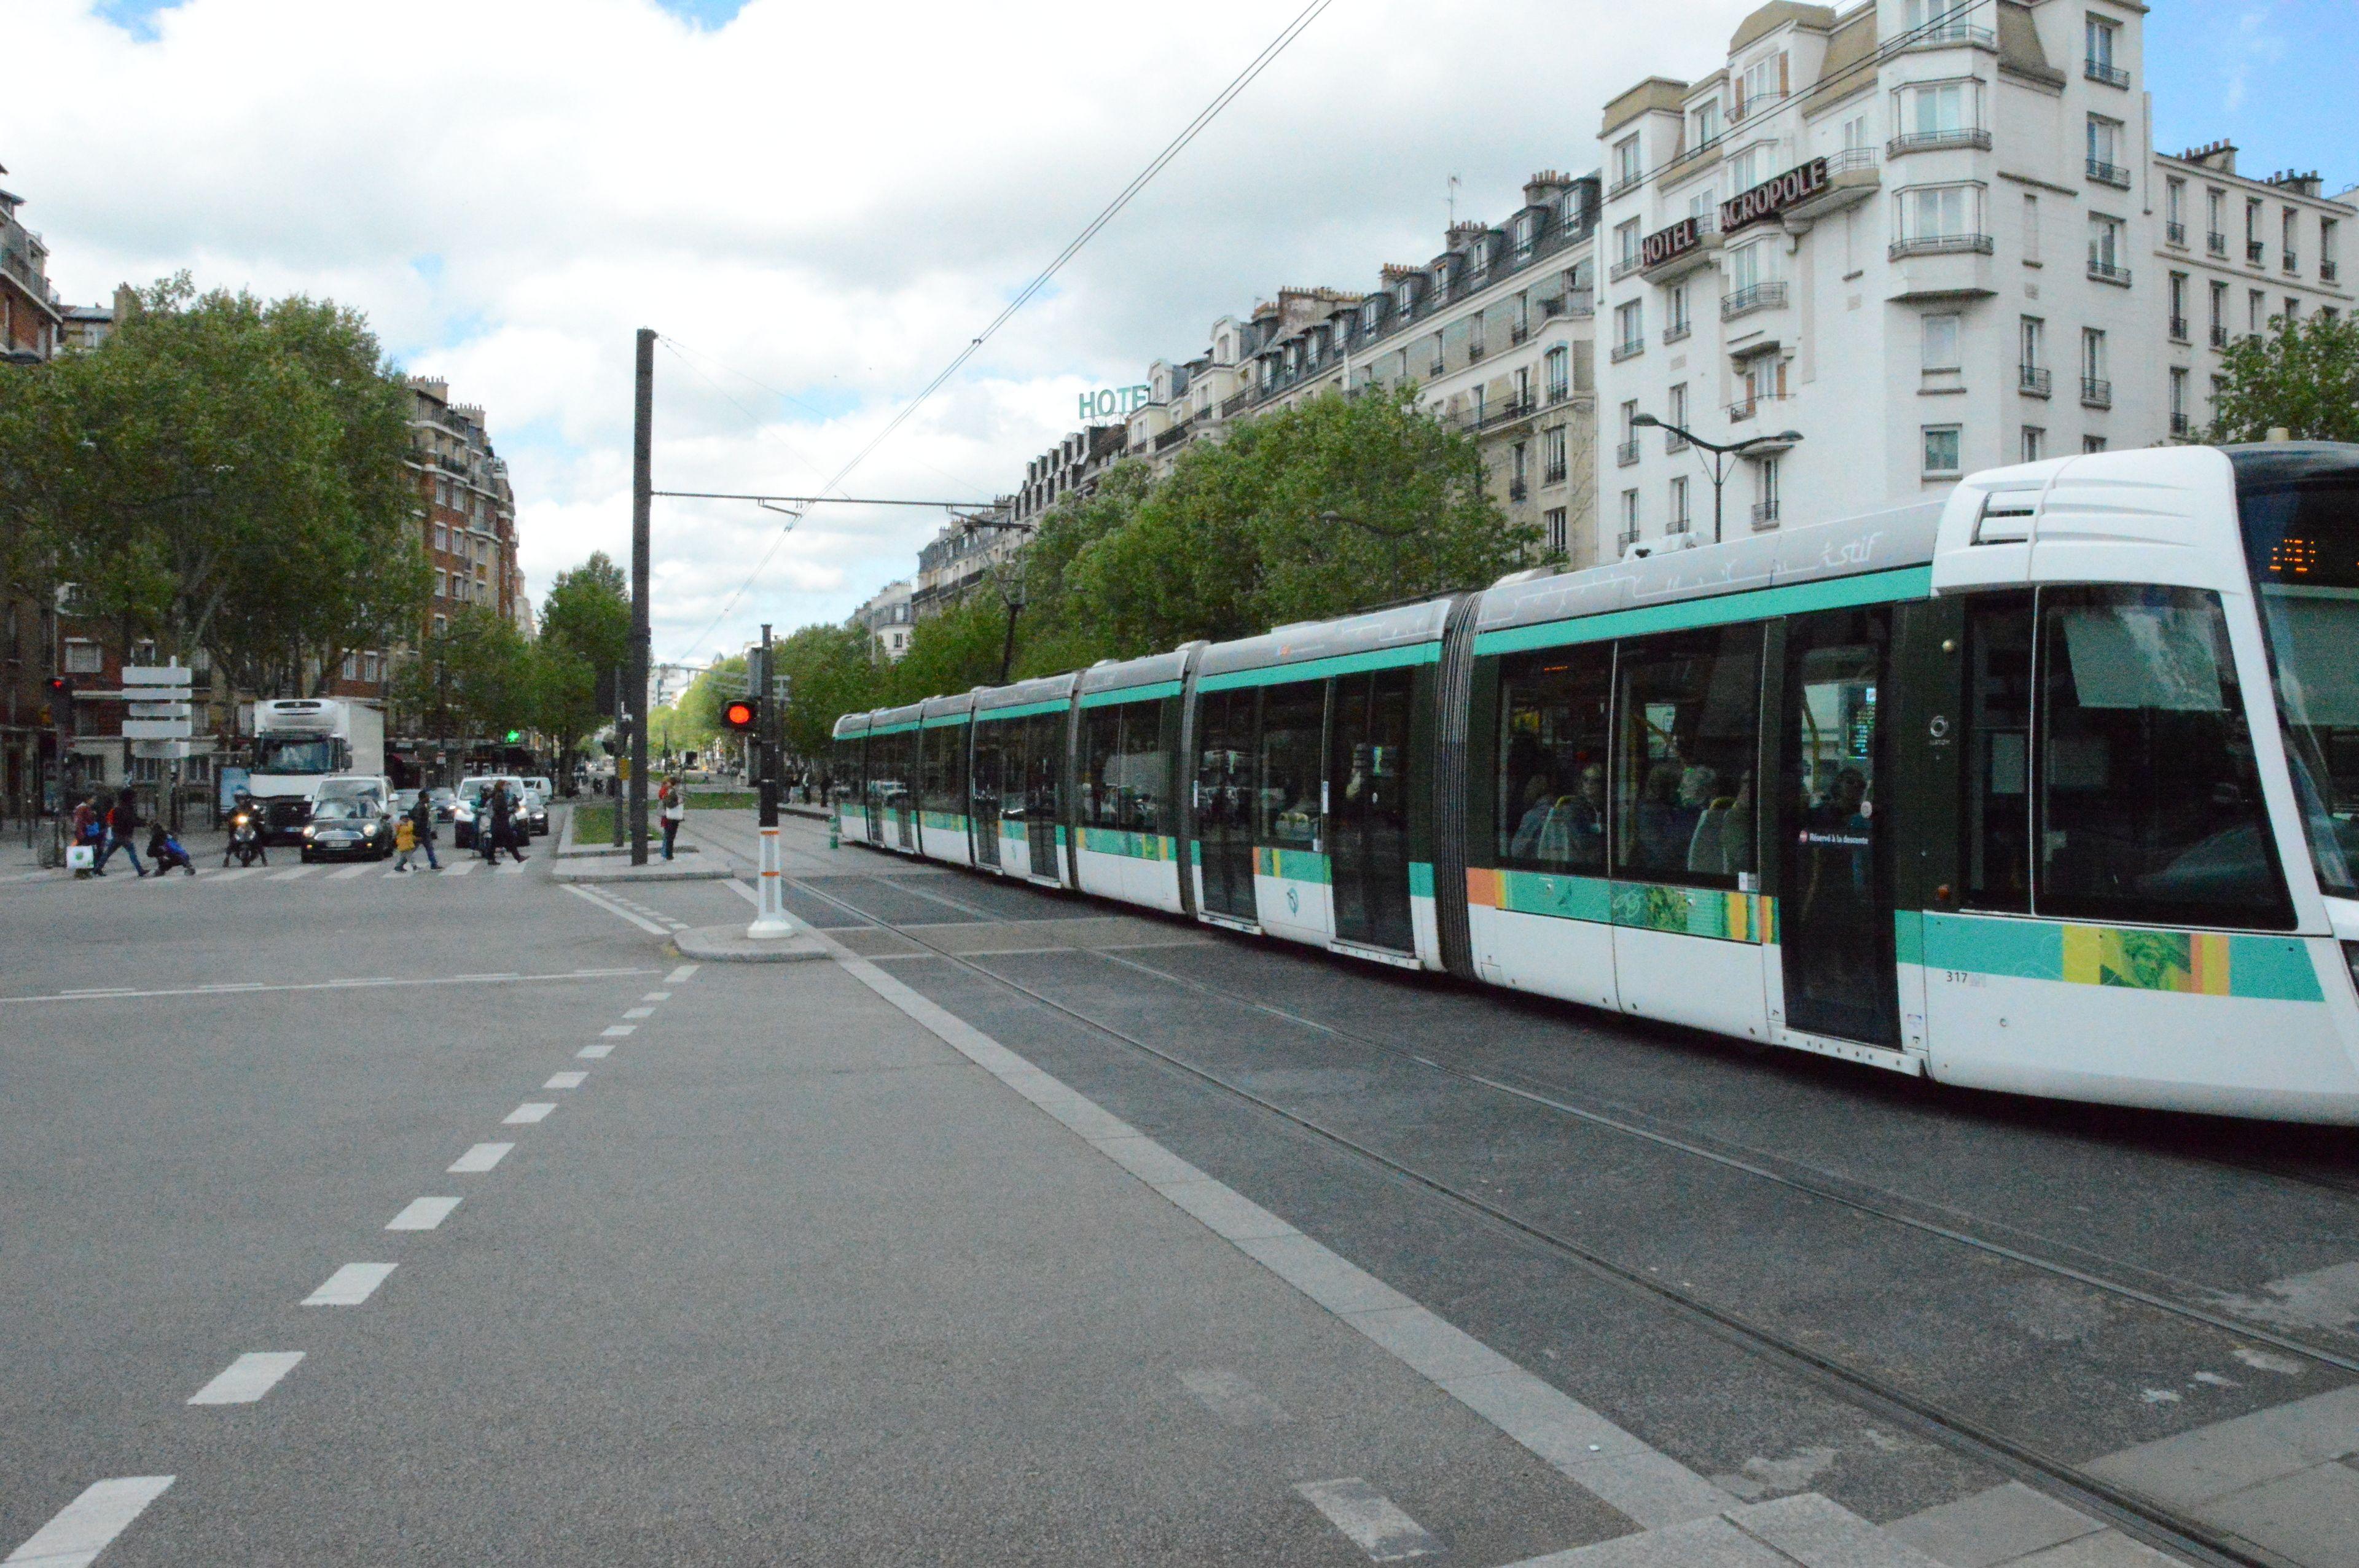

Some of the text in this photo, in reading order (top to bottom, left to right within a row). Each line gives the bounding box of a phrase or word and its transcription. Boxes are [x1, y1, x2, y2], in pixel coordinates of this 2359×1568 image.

[1641, 158, 1826, 267] HOTEL ACROPOLE
[1079, 384, 1147, 419] HOTE
[1946, 971, 1968, 983] 317
